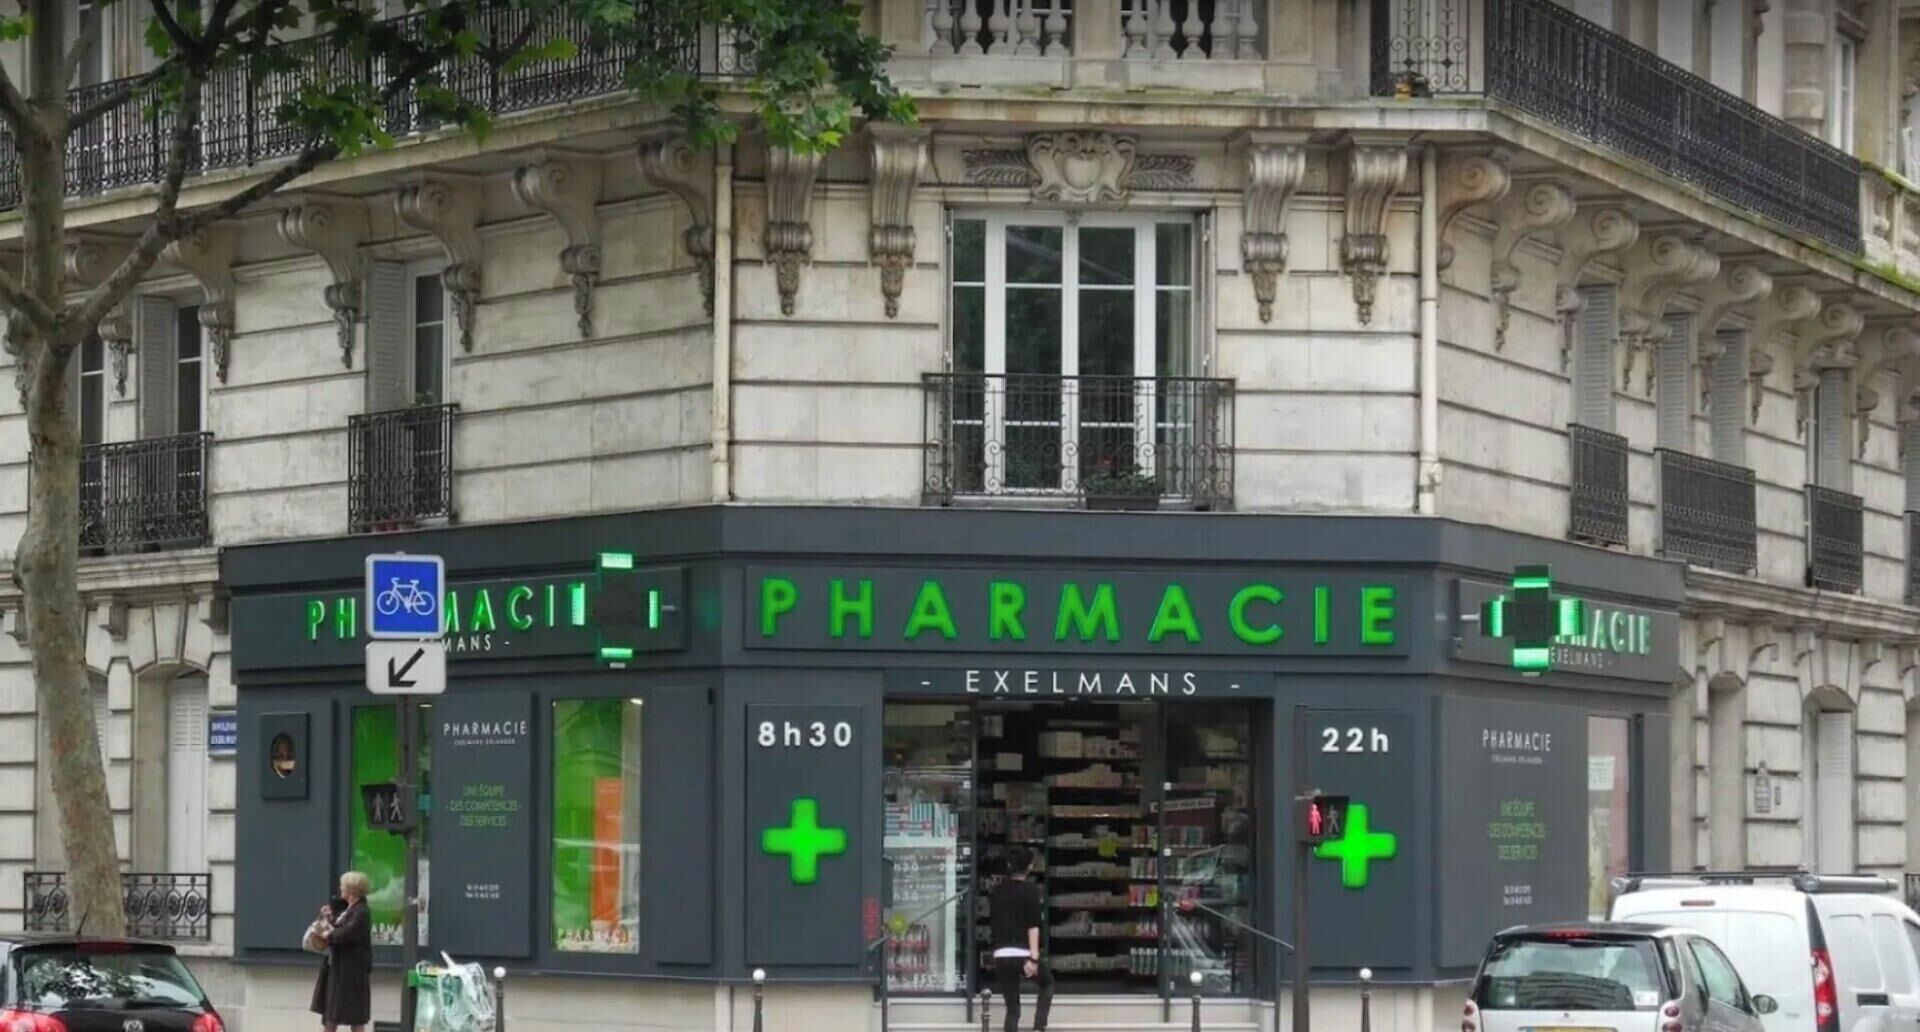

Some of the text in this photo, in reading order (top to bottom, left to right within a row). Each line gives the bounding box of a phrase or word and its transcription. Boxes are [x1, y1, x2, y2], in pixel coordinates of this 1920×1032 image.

[306, 581, 586, 639] PHMACI
[760, 577, 1397, 645] PHARMACIE
[966, 670, 1197, 696] EXELMANS
[443, 720, 527, 736] PHARMACIE
[758, 721, 852, 747] 8h30
[1321, 727, 1389, 753] 22h
[1482, 728, 1552, 753] PHARMACIE
